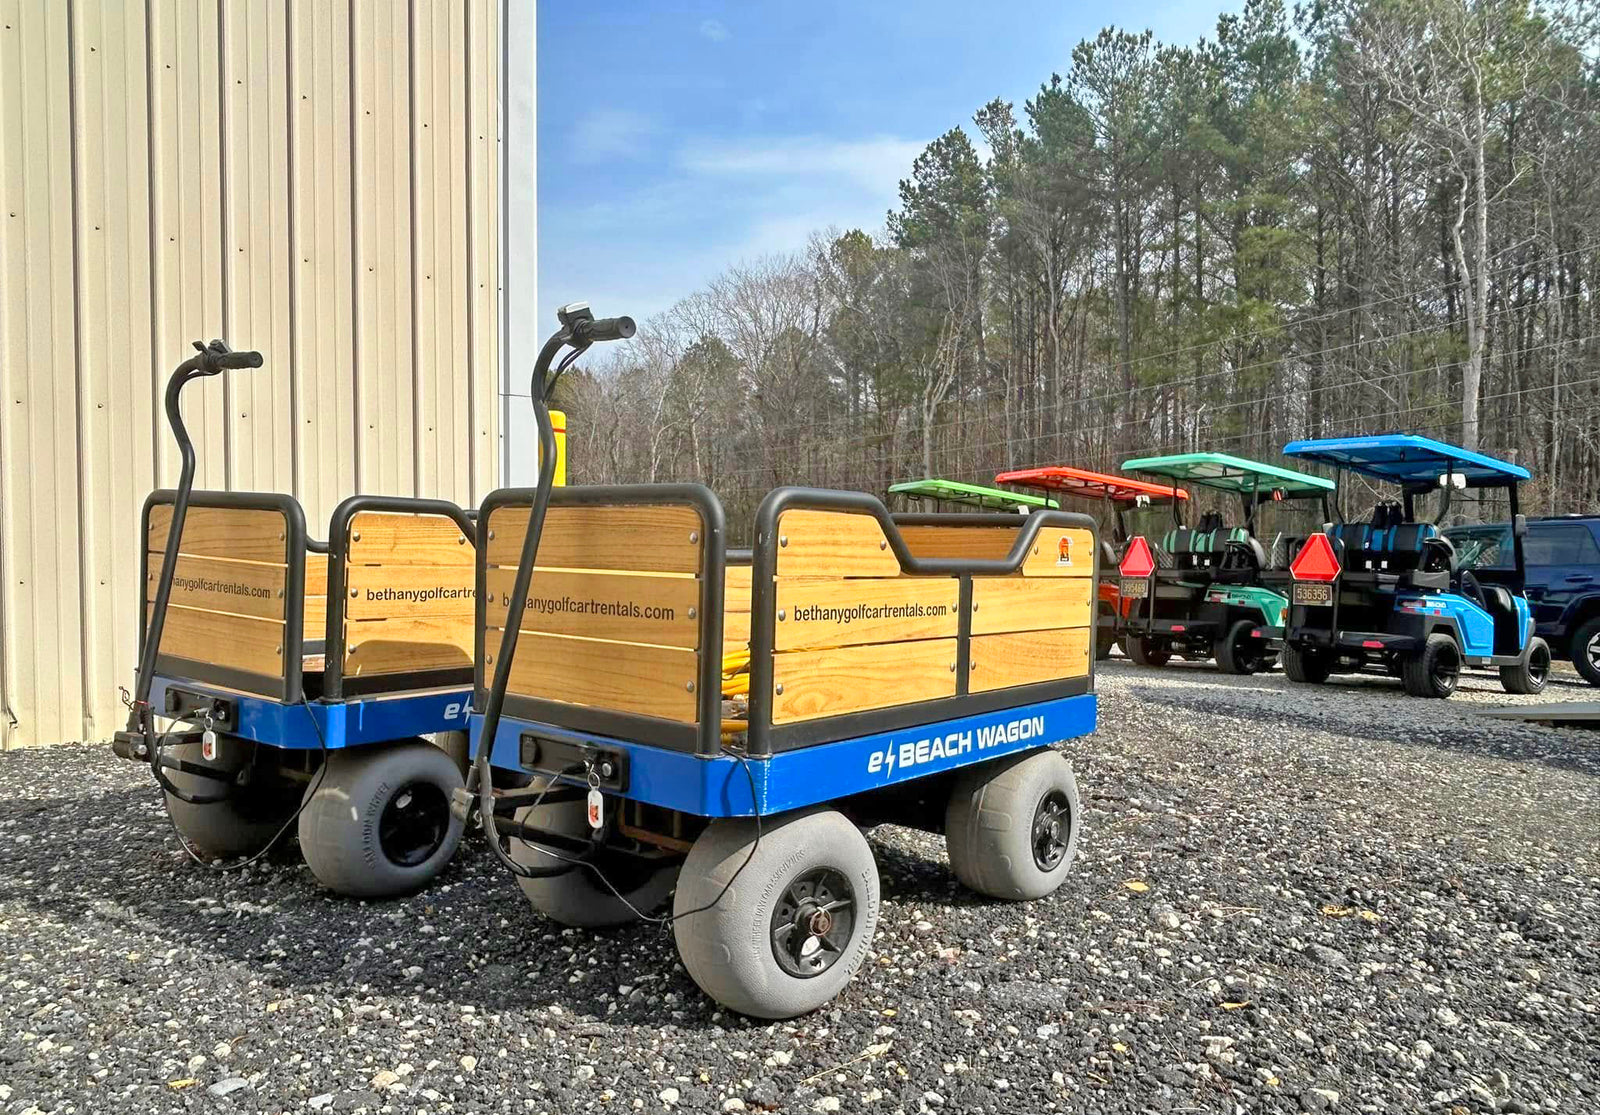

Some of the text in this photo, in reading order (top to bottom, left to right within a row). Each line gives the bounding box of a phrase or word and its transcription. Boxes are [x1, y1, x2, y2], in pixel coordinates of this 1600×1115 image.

[502, 593, 674, 621] banygolfcartrentals.com
[1297, 588, 1328, 601] 536356
[794, 602, 947, 624] bethanygolfcartrentals.com
[898, 730, 972, 768] BEACH
[976, 715, 1045, 750] WAGON
